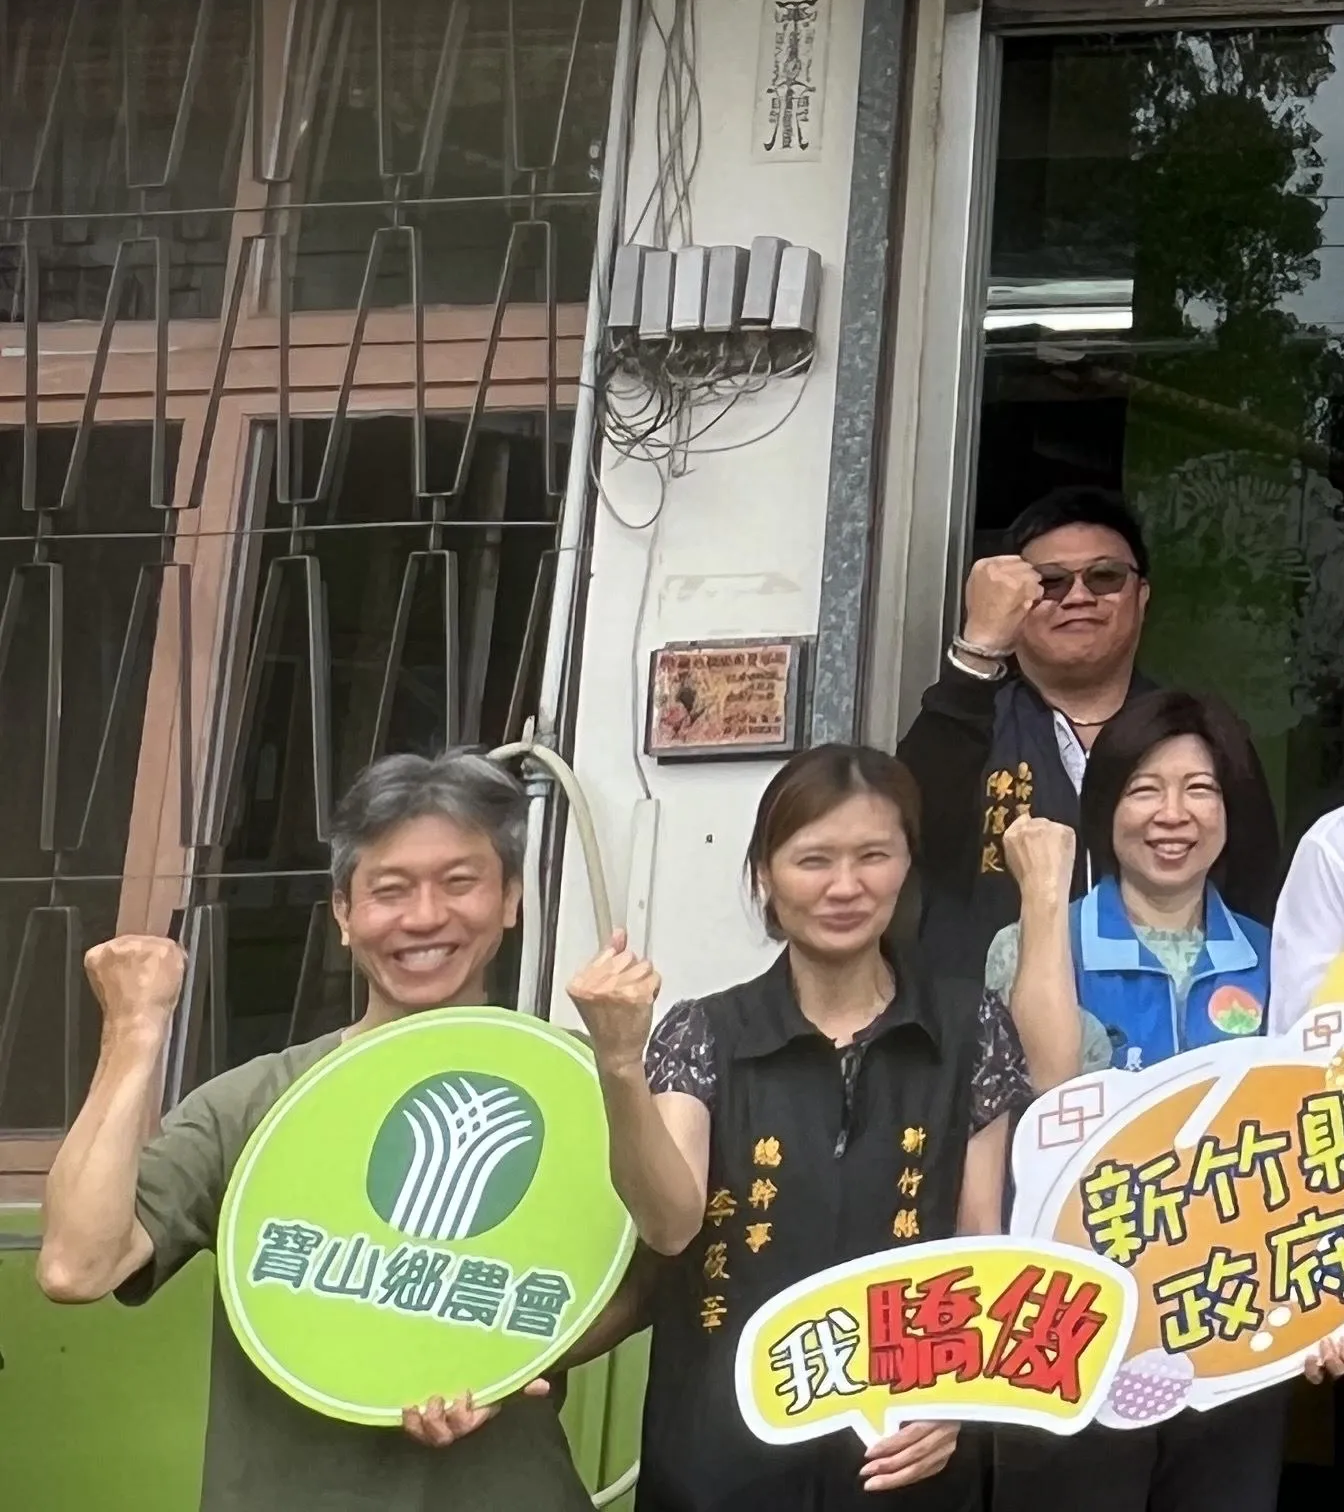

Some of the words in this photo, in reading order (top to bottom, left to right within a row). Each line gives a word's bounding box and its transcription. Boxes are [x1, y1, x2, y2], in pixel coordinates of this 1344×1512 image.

[250, 1221, 572, 1338] 寶山鄉農會
[770, 1264, 1108, 1416] 我驕傲
